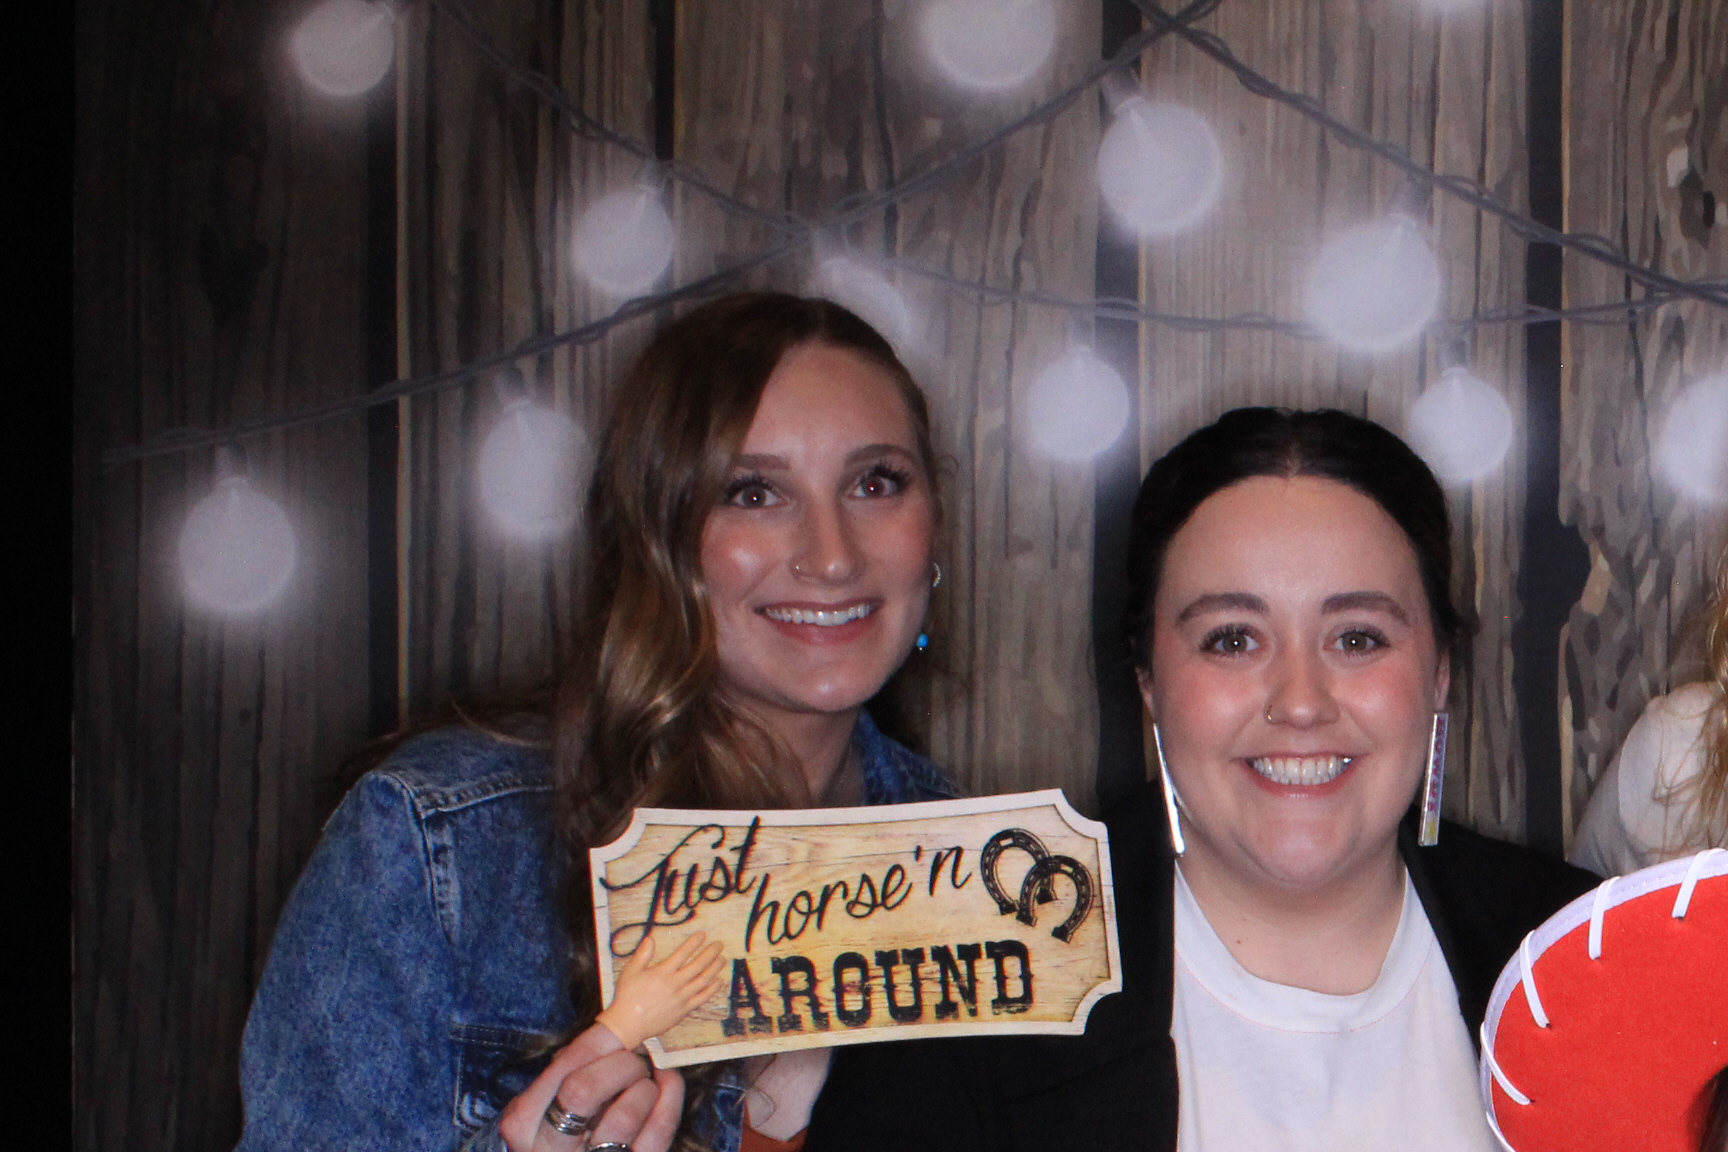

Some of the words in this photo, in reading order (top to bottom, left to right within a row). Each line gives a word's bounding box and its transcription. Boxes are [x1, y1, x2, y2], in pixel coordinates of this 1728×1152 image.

[599, 815, 760, 957] Just
[745, 845, 973, 951] horse'n
[721, 939, 1035, 1038] AROUND
